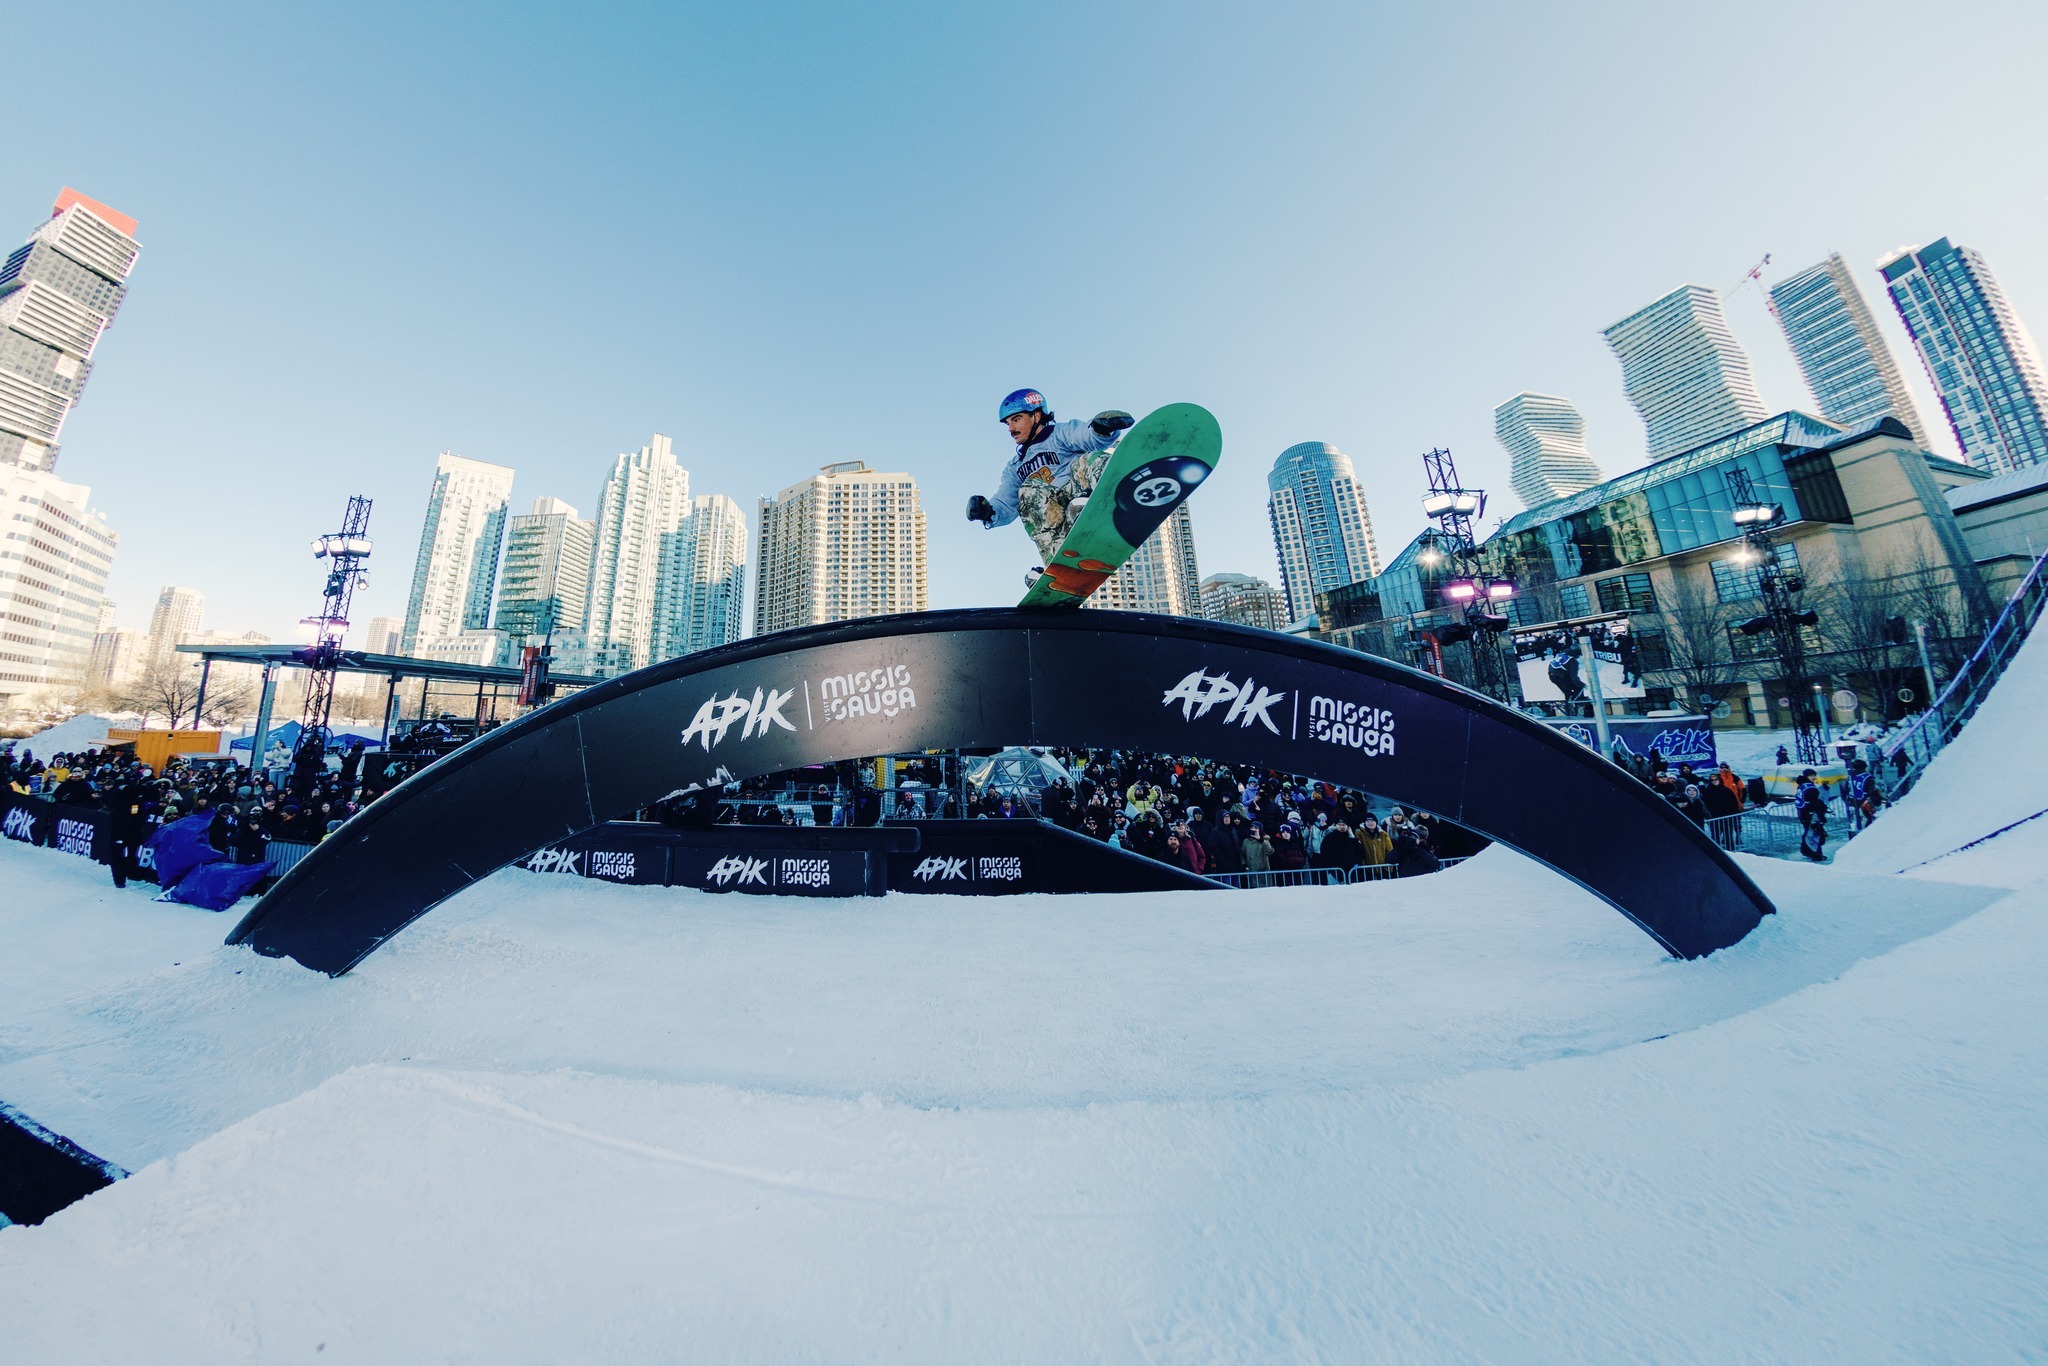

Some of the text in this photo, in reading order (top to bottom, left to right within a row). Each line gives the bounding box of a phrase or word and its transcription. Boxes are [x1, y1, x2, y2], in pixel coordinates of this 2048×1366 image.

[1137, 481, 1176, 503] 32
[1594, 651, 1622, 663] TRIBU
[821, 664, 911, 700] MISSIS
[823, 701, 831, 723] VISIT
[1161, 666, 1286, 736] APIK
[1310, 695, 1395, 732] MISSIS
[681, 686, 798, 754] APIK
[1308, 717, 1316, 739] VISIT
[1648, 728, 1713, 758] APIK
[3, 806, 38, 842] APIK
[57, 818, 94, 841] MISSIS
[526, 847, 583, 874] APIK
[592, 851, 635, 865] MISSIS
[706, 855, 769, 887] APIK
[782, 859, 830, 872] MISSIS
[912, 855, 968, 883] APIK
[979, 857, 1021, 868] MISSIS
